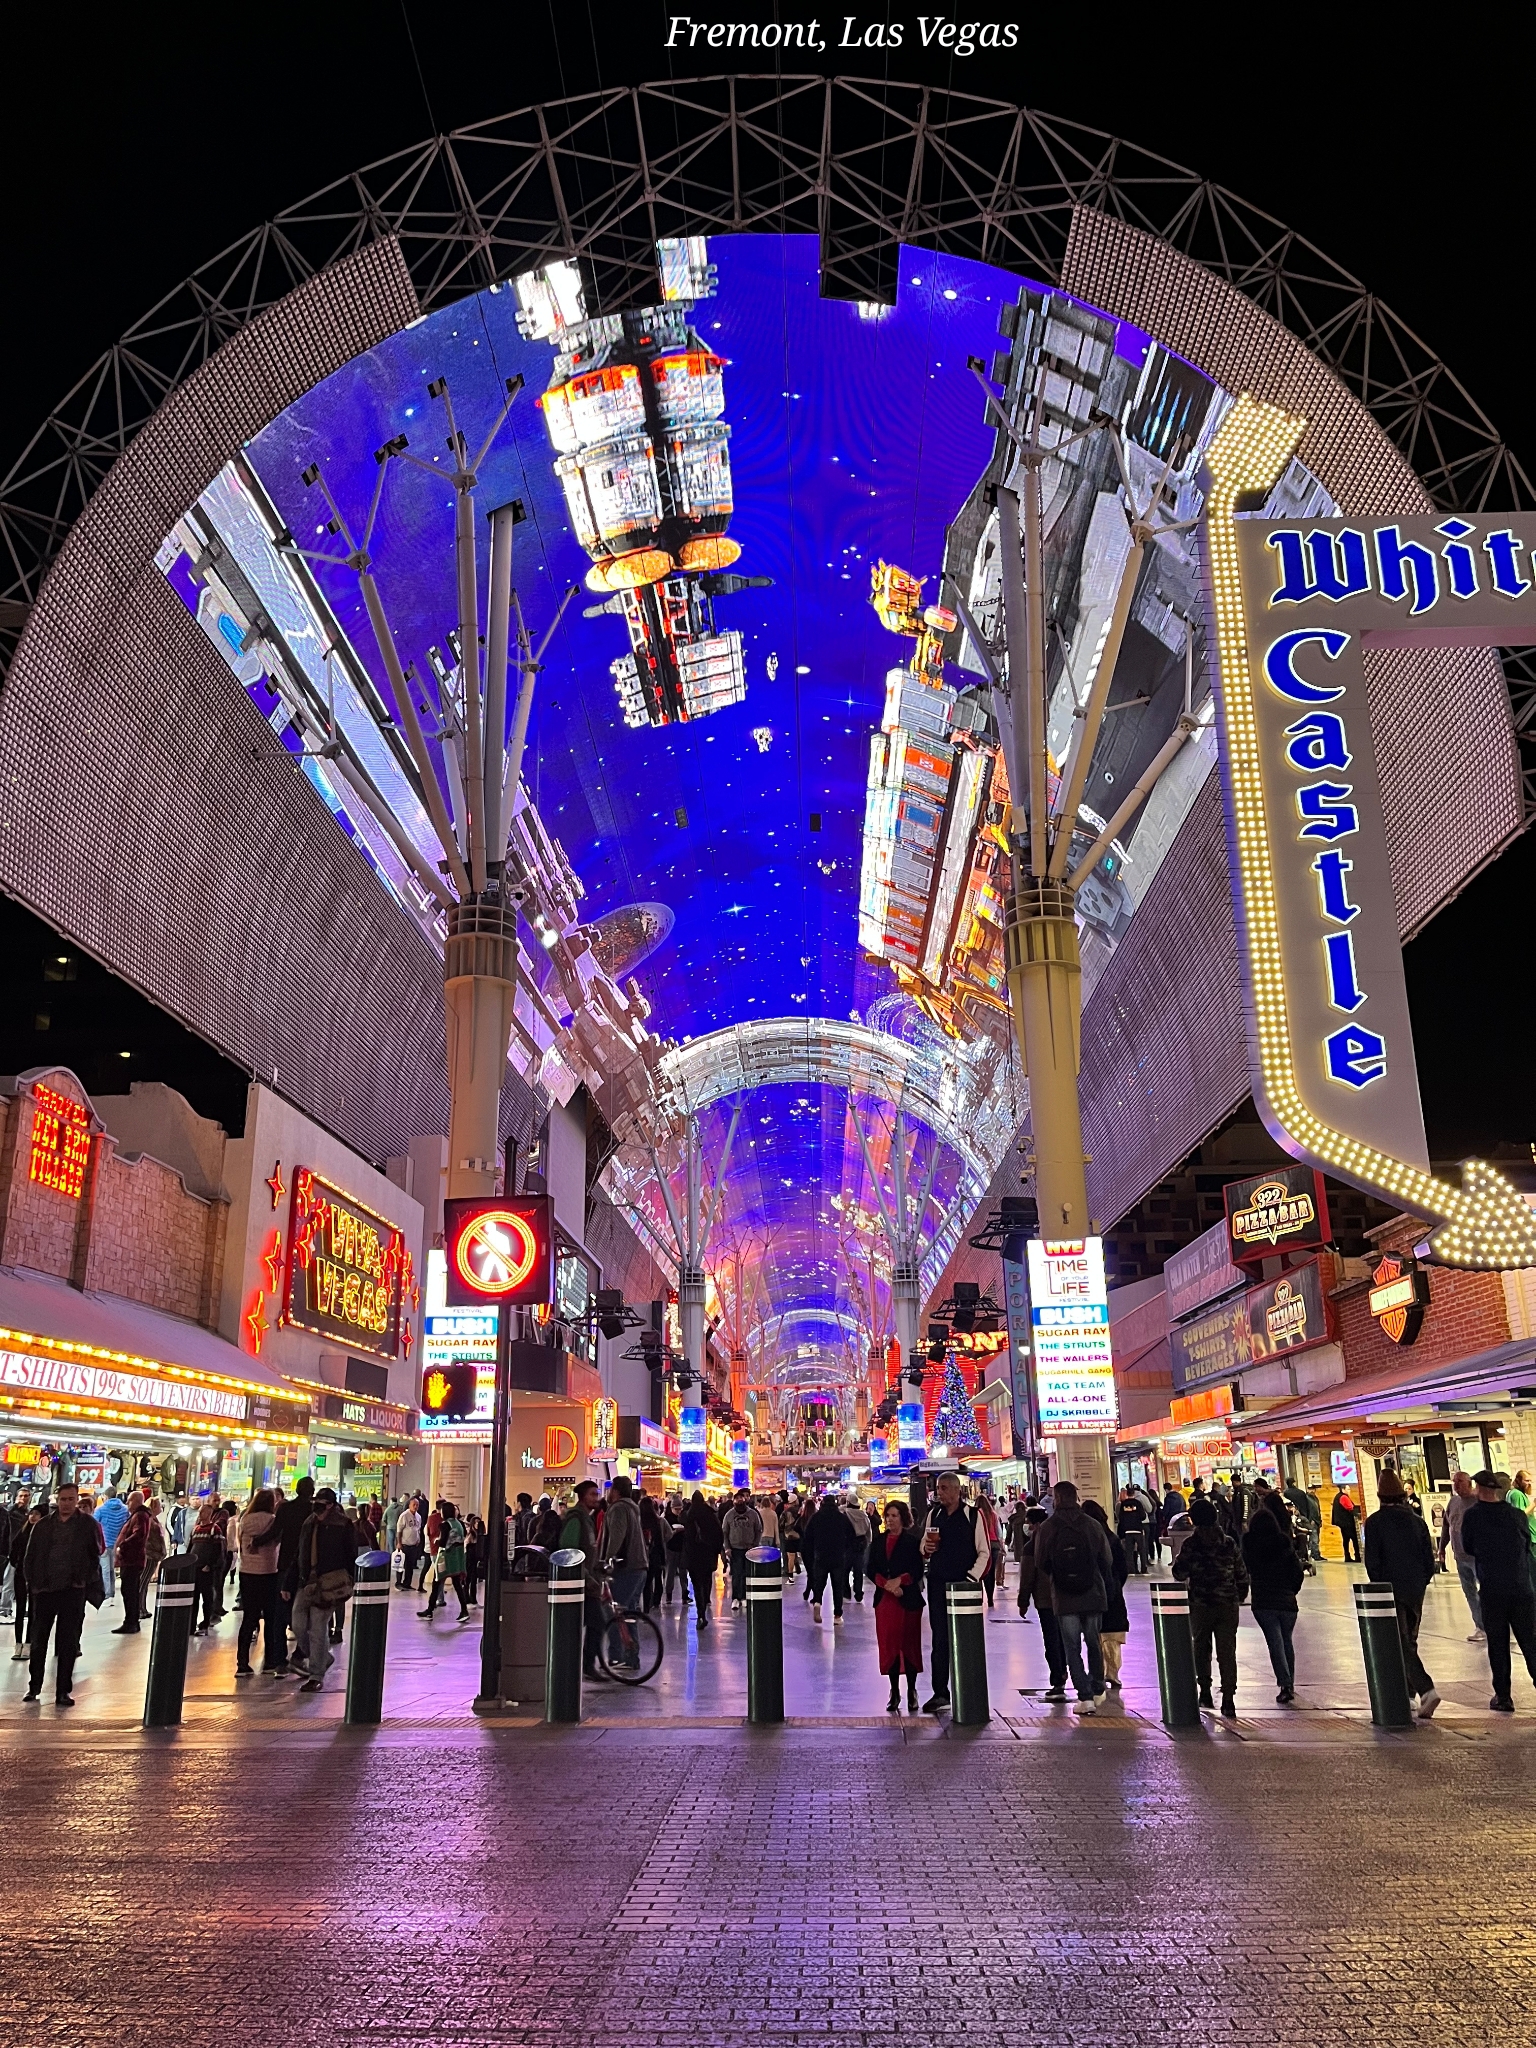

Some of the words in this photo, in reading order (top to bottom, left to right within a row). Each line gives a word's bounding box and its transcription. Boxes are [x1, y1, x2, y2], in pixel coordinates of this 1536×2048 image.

[1264, 516, 1536, 616] Whit
[1262, 627, 1387, 1090] Castle
[1257, 1188, 1281, 1209] 322
[1236, 1207, 1278, 1233] PIZZA
[1278, 1200, 1309, 1223] BAR
[329, 1203, 381, 1278] VIVA
[1046, 1241, 1084, 1255] NYE
[1043, 1259, 1088, 1273] TIME
[315, 1256, 388, 1334] VEGAS
[1049, 1281, 1091, 1295] LIFE
[1040, 1306, 1103, 1325] BUSH
[432, 1318, 493, 1334] BUSH
[1037, 1329, 1079, 1337] SUGAR
[1083, 1327, 1107, 1336] RAY
[1183, 1311, 1230, 1348] SOUVENIRS
[427, 1339, 469, 1347] SUGAR
[472, 1339, 496, 1347] RAY
[1063, 1341, 1106, 1349] STRUTS
[1188, 1334, 1227, 1362] T-SHIRTS
[428, 1352, 449, 1360] THE
[452, 1352, 493, 1360] STRUTS
[1063, 1354, 1109, 1362] WAILERS
[1, 1352, 91, 1394] T-SHIRTS
[1039, 1368, 1085, 1376] SUGARHILL
[1088, 1367, 1112, 1375] GANG
[1185, 1349, 1235, 1382] BEVERAGES
[1047, 1382, 1070, 1390] TAG
[1074, 1381, 1106, 1389] TEAM
[127, 1377, 208, 1412] SOUVENIRS
[1047, 1395, 1107, 1403] ALL-4-ONE
[213, 1391, 244, 1418] BEER
[342, 1402, 366, 1423] HATS
[370, 1408, 404, 1430] LIQUOR
[1061, 1409, 1111, 1417] SKRIBBLE
[1080, 1420, 1115, 1428] TICKETS
[521, 1447, 544, 1469] the
[545, 1425, 578, 1469] D
[1165, 1441, 1233, 1456] LIQUOR
[360, 1451, 401, 1463] LIQUOR
[354, 1486, 382, 1498] VAPE
